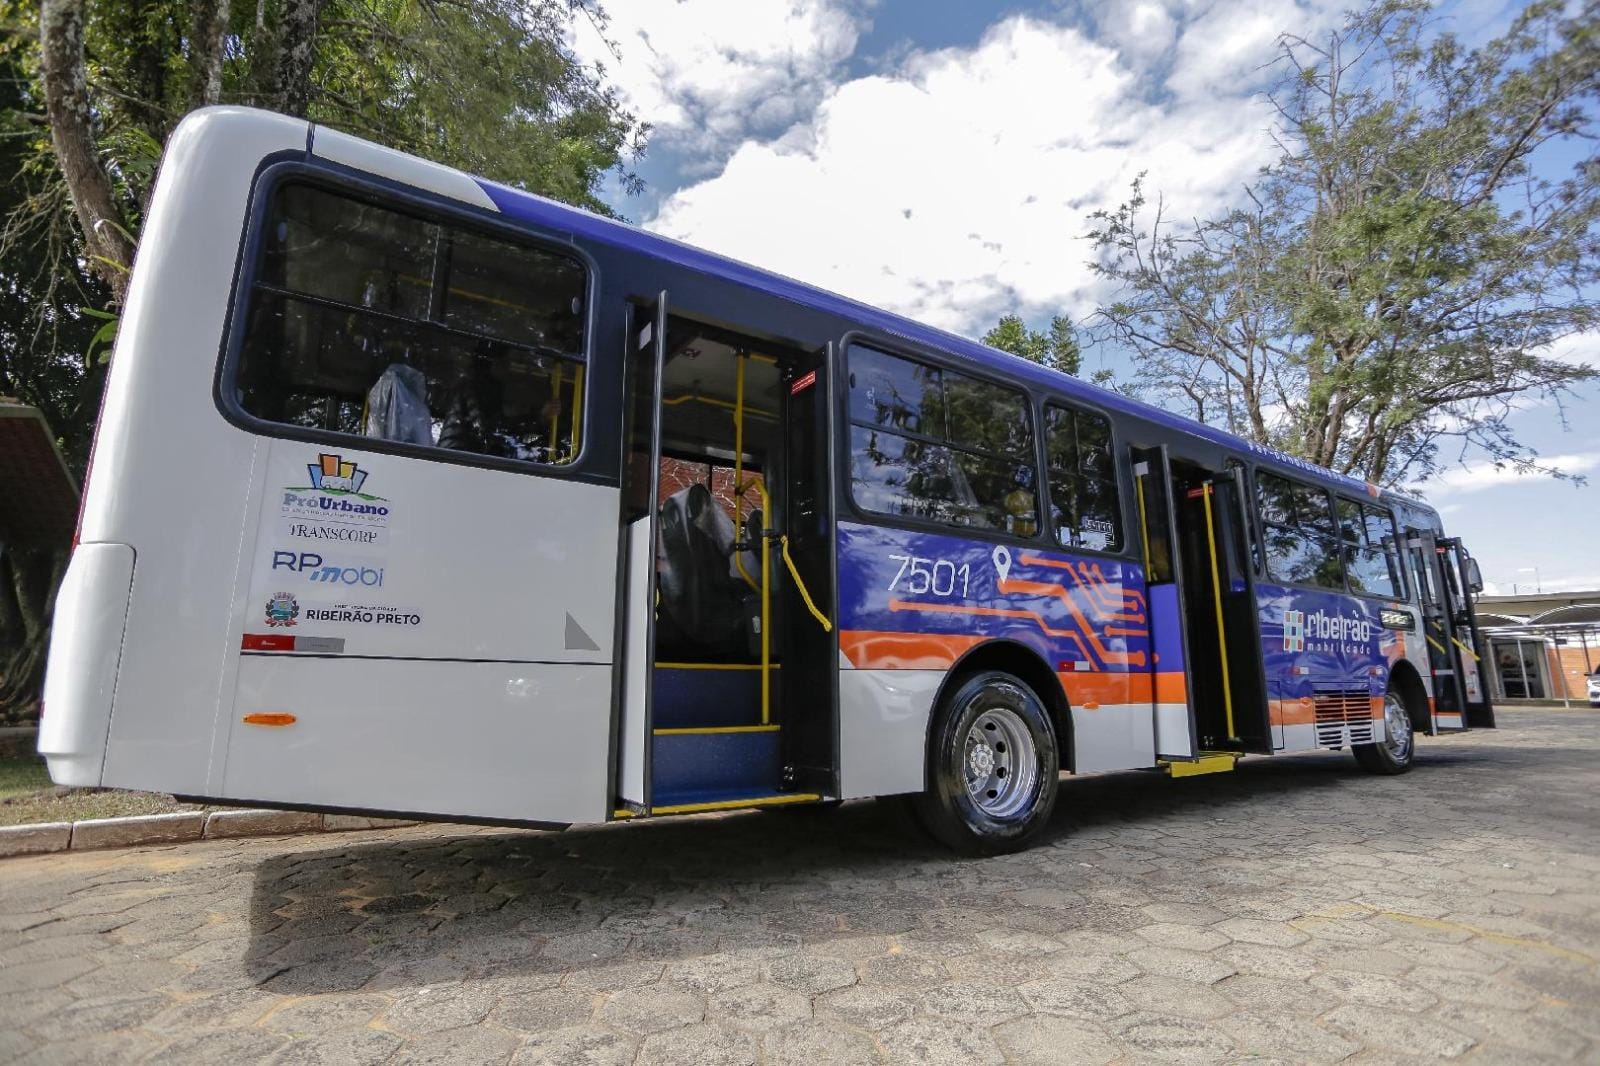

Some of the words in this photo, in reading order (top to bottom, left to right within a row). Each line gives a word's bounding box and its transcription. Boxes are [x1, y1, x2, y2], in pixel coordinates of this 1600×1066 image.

[289, 524, 377, 544] TRANSCORP
[888, 554, 970, 598] 7501
[306, 609, 373, 623] RIBEIRÃO
[376, 613, 421, 625] PRETO
[1304, 608, 1370, 643] ribeirão
